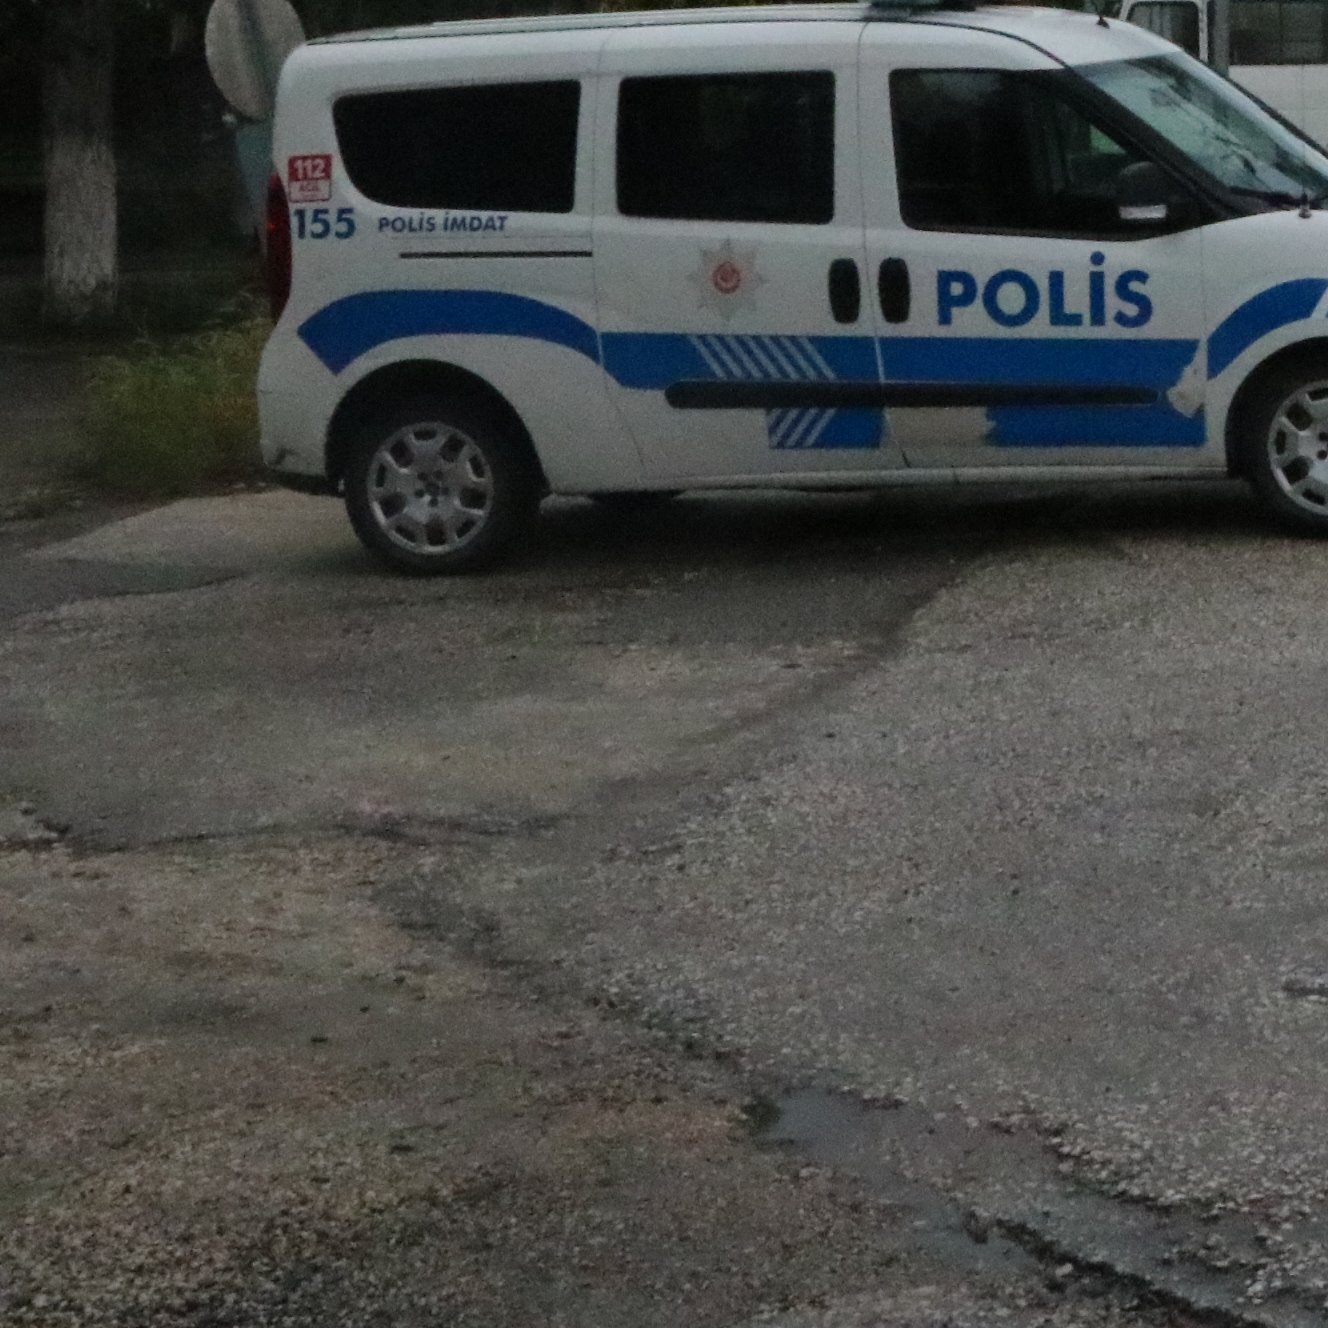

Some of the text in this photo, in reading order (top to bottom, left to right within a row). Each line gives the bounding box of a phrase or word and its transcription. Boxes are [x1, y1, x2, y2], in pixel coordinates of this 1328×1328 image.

[293, 158, 326, 179] 112
[293, 207, 509, 240] 155 POLİS İMDAT
[936, 251, 1153, 329] POLİS
